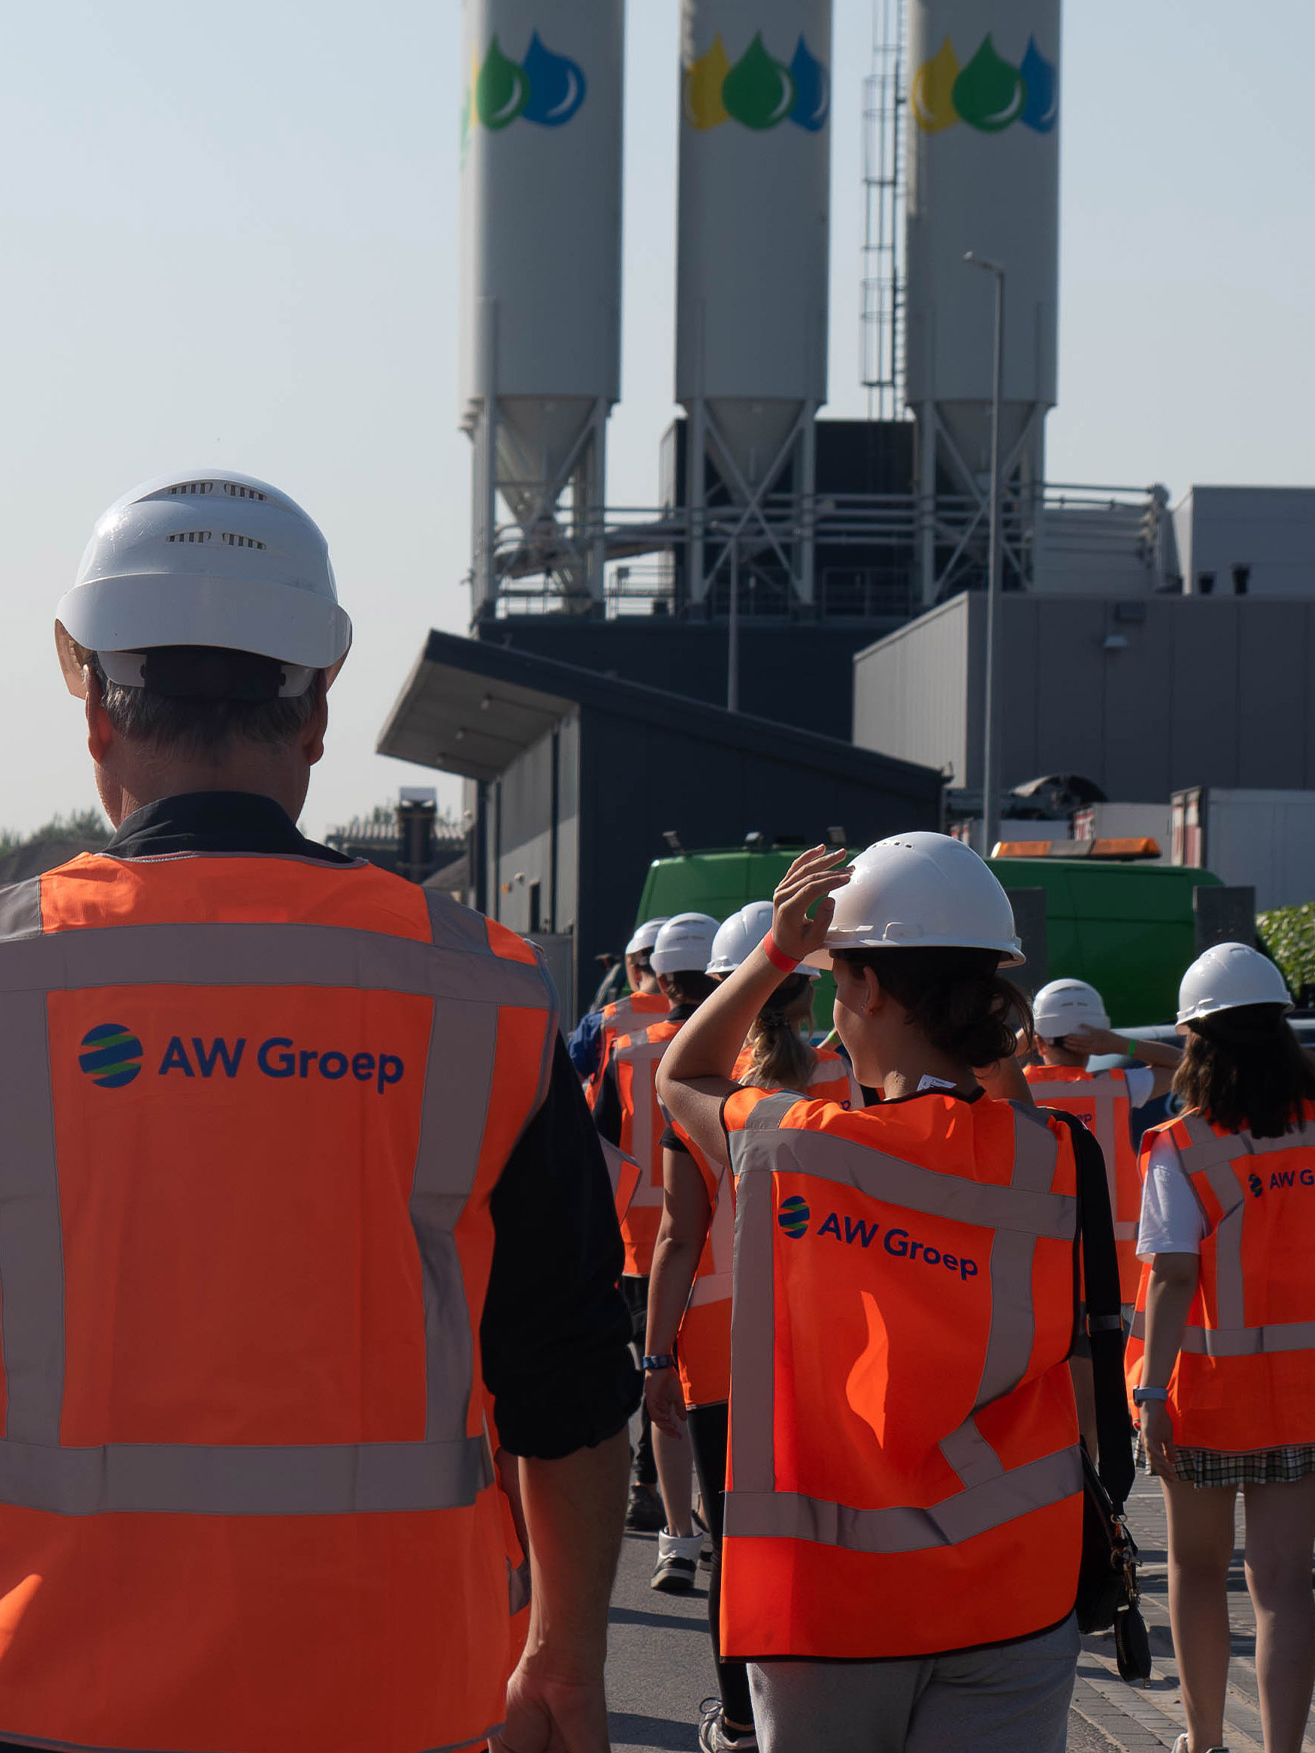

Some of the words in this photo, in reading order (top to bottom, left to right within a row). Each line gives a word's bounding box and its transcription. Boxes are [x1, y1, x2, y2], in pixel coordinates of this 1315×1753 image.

[158, 1036, 246, 1078] AW
[257, 1037, 404, 1094] Groep
[1269, 1170, 1295, 1190] AW
[1299, 1169, 1315, 1186] G
[817, 1212, 879, 1248] AW
[884, 1228, 978, 1281] Groep
